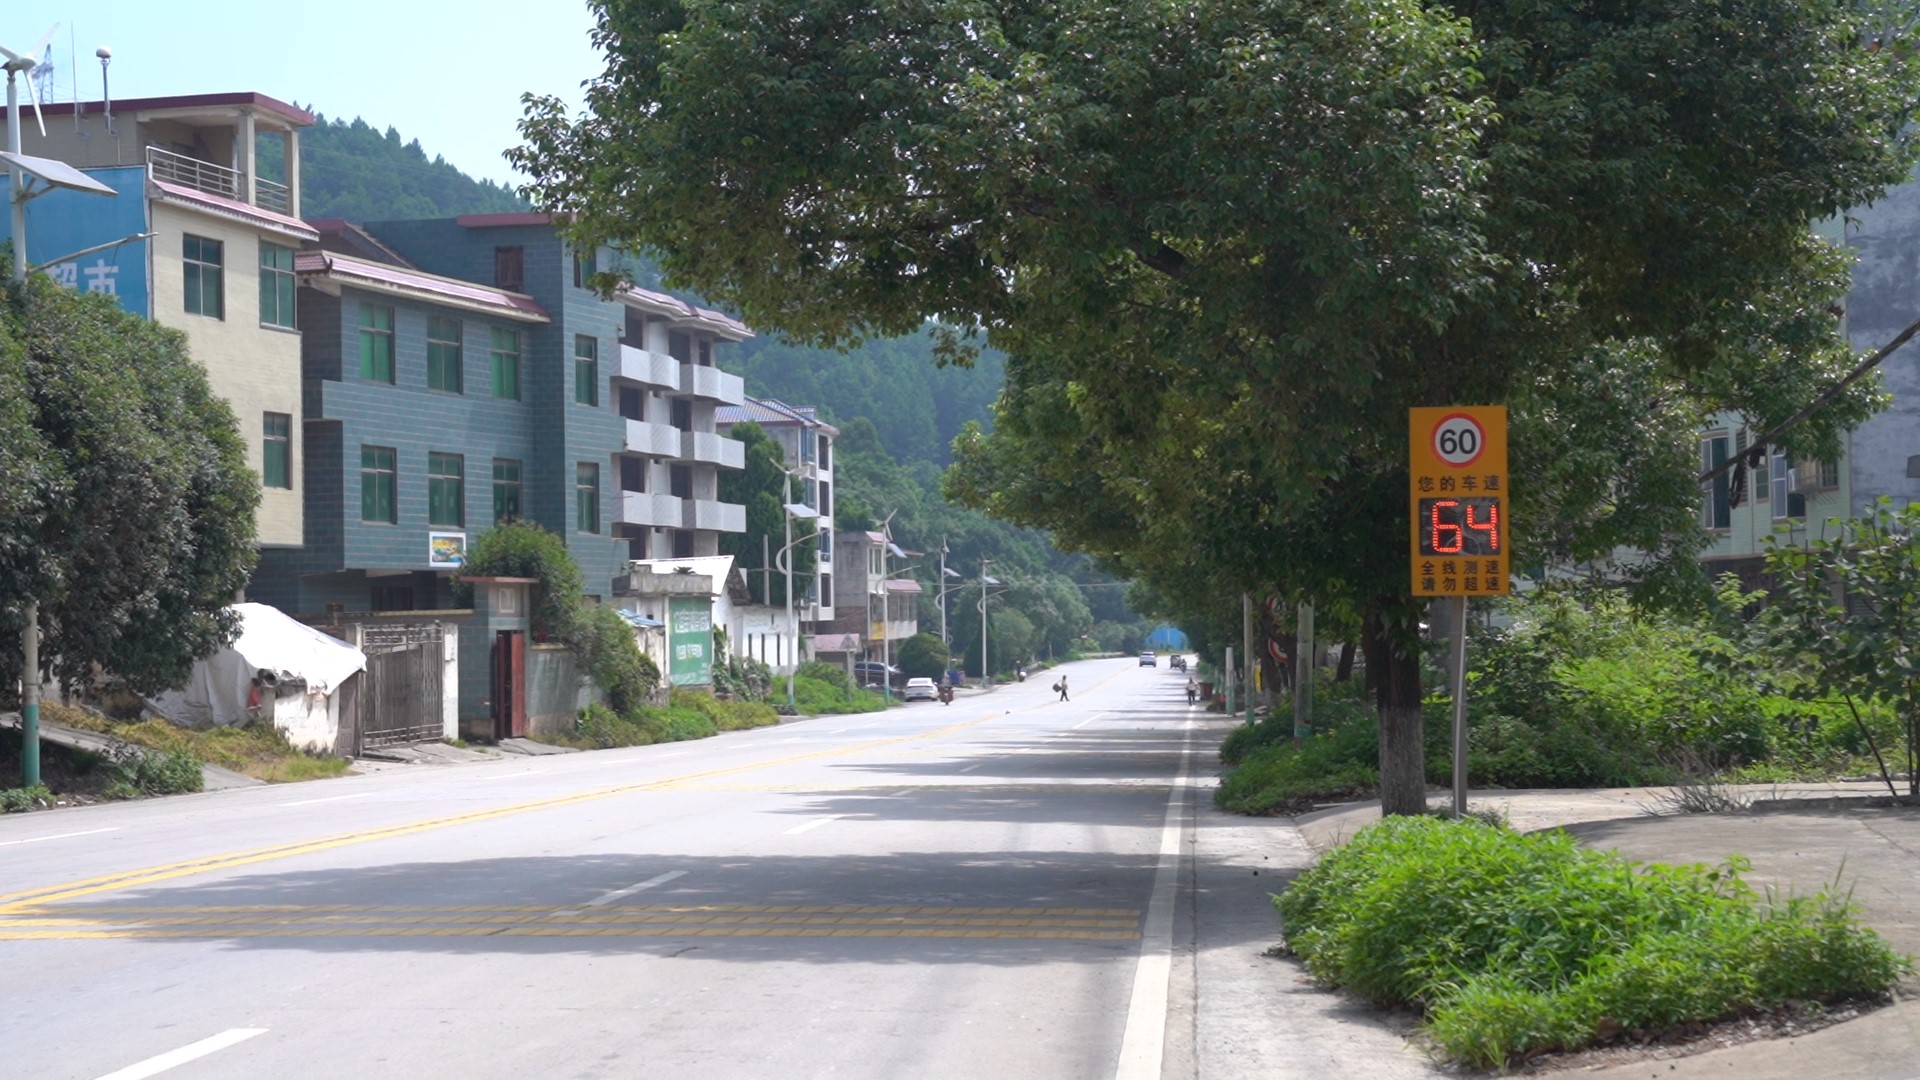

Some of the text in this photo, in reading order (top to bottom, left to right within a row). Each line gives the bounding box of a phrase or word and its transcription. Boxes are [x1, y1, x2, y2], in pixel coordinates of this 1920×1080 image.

[1440, 429, 1476, 454] 60
[1418, 475, 1500, 491] 您的车速
[1432, 501, 1498, 552] 64
[1421, 561, 1499, 575] 全线测速
[1421, 577, 1499, 591] 请勿超速
